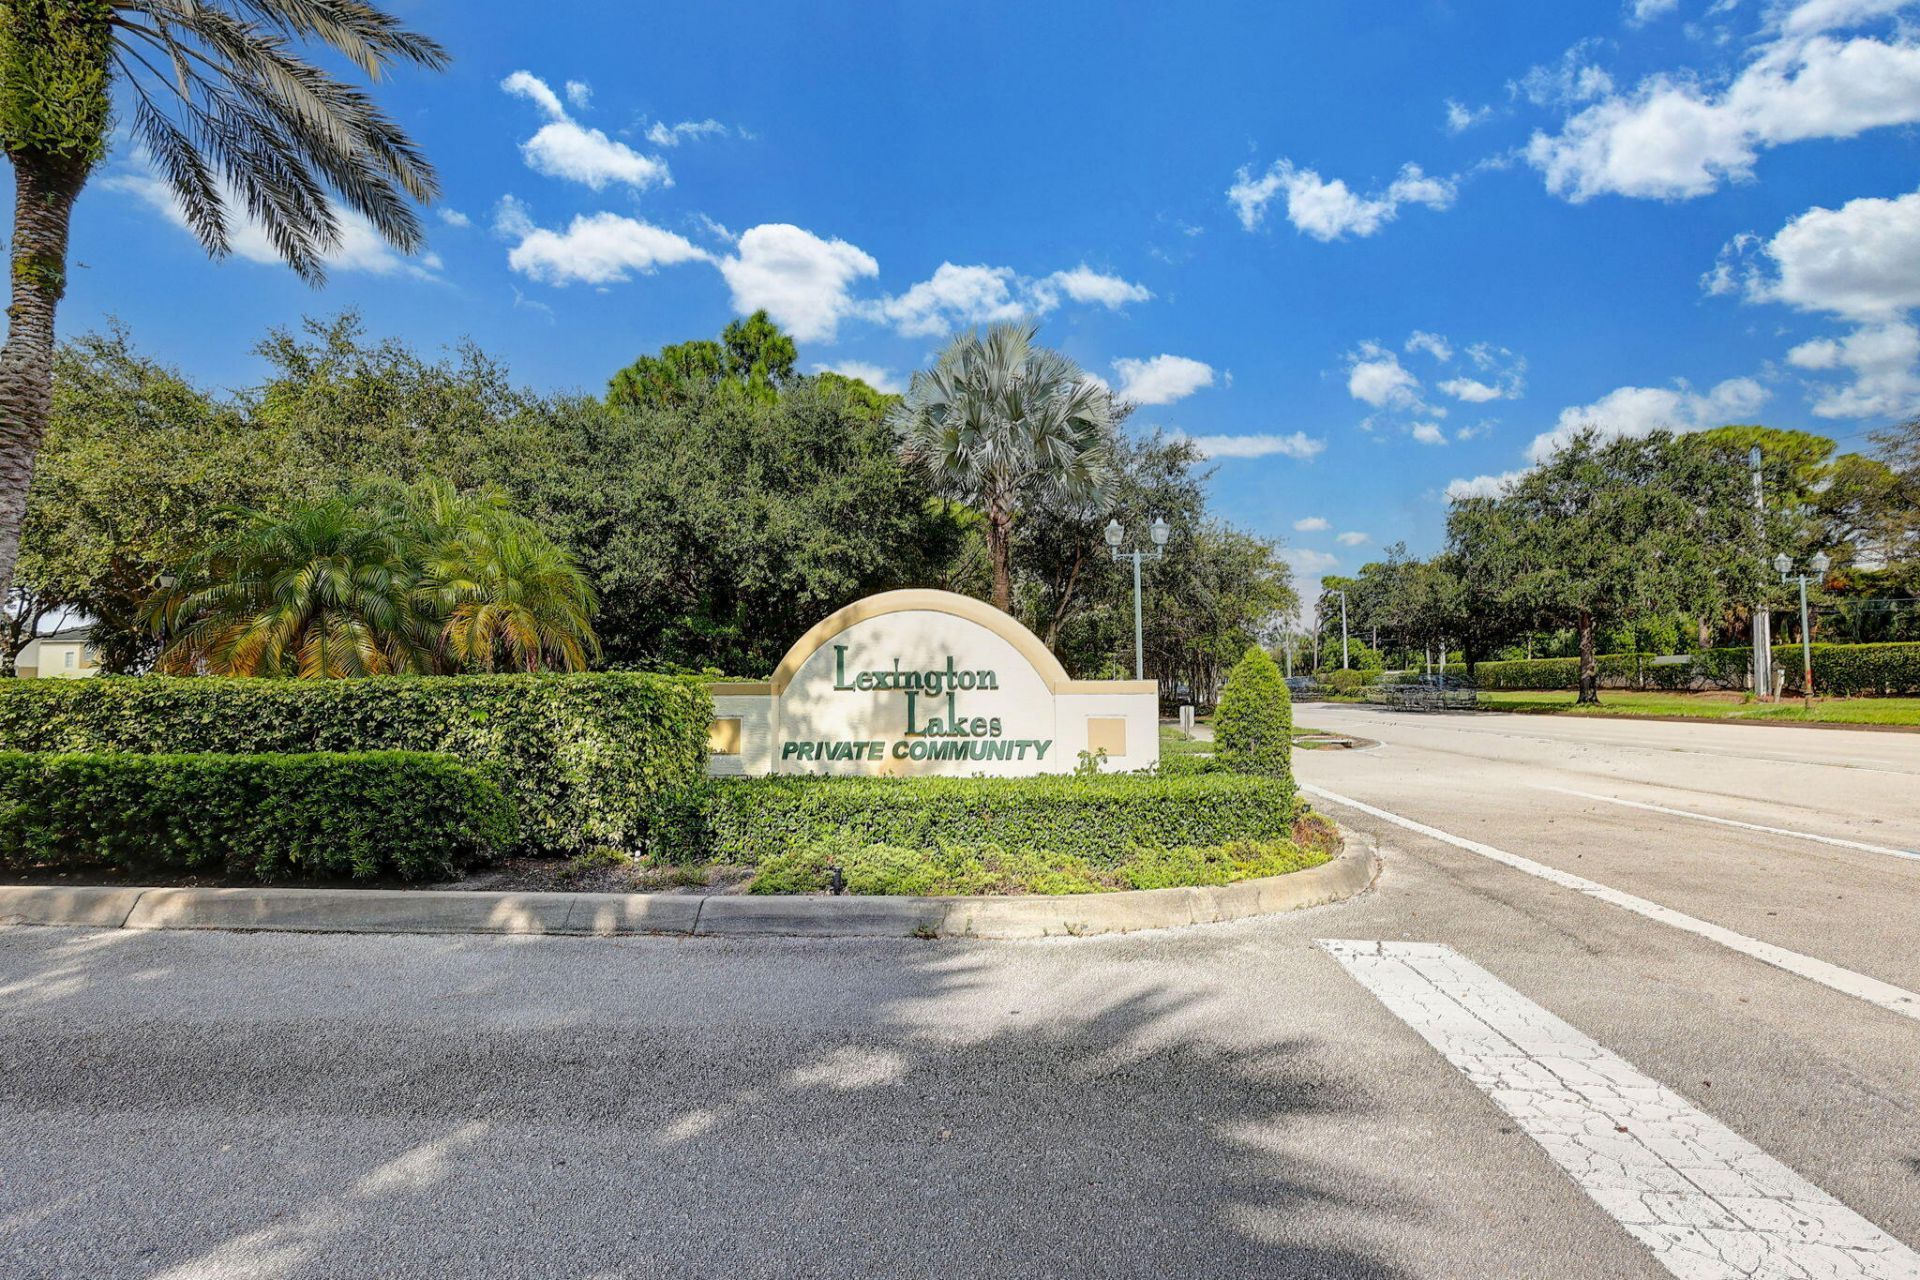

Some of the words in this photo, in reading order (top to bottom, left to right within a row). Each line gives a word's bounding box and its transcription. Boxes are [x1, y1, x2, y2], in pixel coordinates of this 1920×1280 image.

[833, 645, 999, 697] Lexington
[905, 690, 1002, 737] Lakes
[782, 741, 885, 760] PRIVATE
[892, 740, 1052, 760] COMMUNITY
